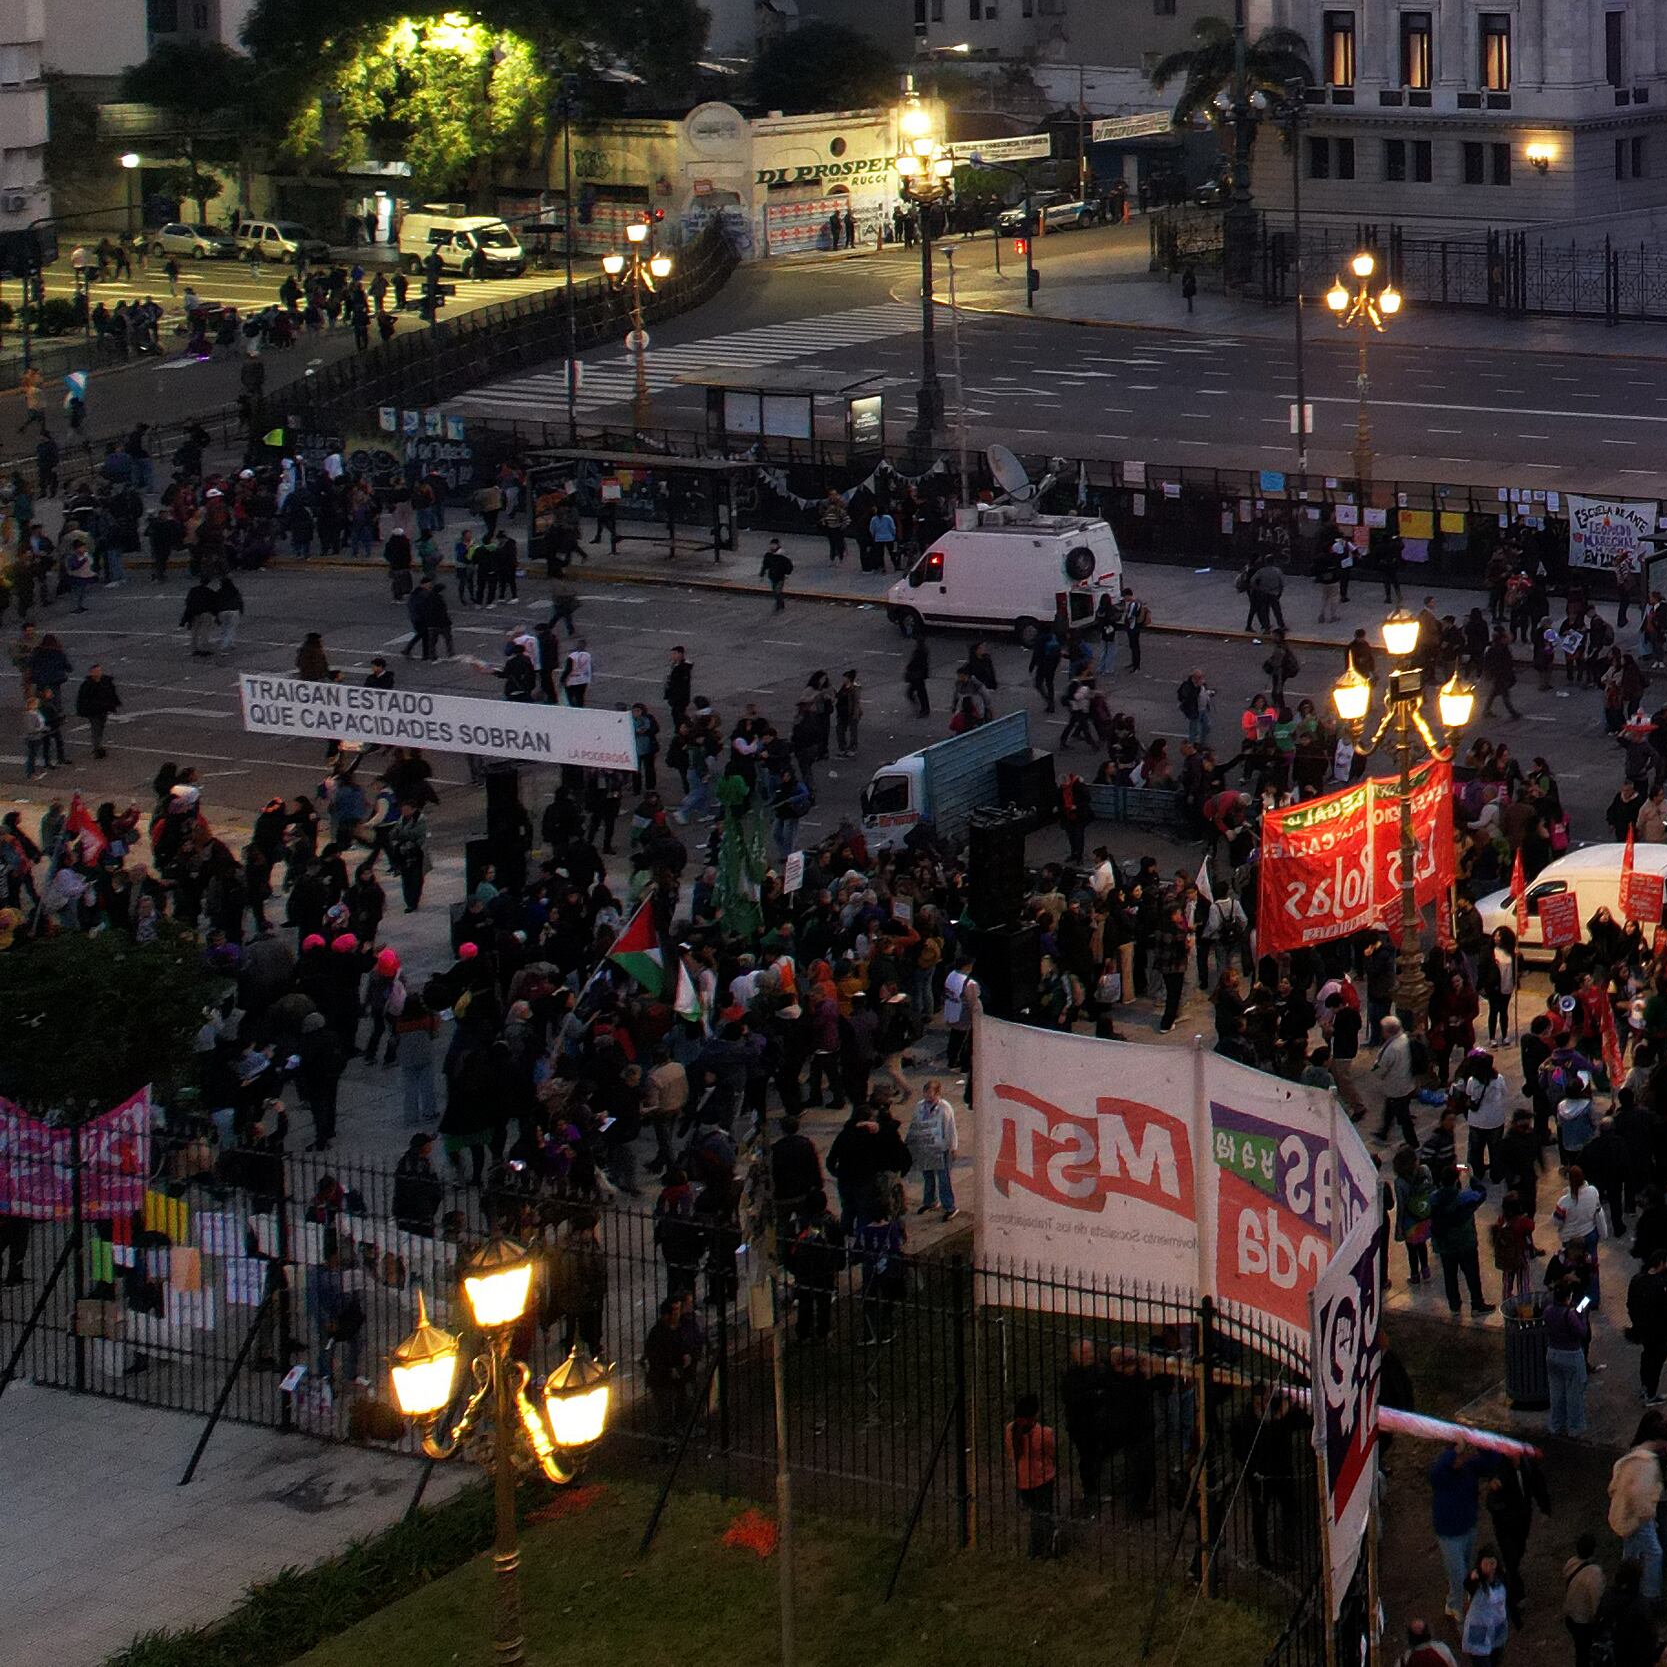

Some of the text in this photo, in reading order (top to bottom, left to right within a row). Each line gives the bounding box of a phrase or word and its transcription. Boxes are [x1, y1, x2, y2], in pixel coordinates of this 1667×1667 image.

[756, 168, 788, 184] DI
[851, 174, 887, 186] RUCCI
[246, 679, 433, 716] TRAIGAN ESTADO
[249, 703, 294, 727] QUE
[300, 707, 453, 743] CAPACIDADES
